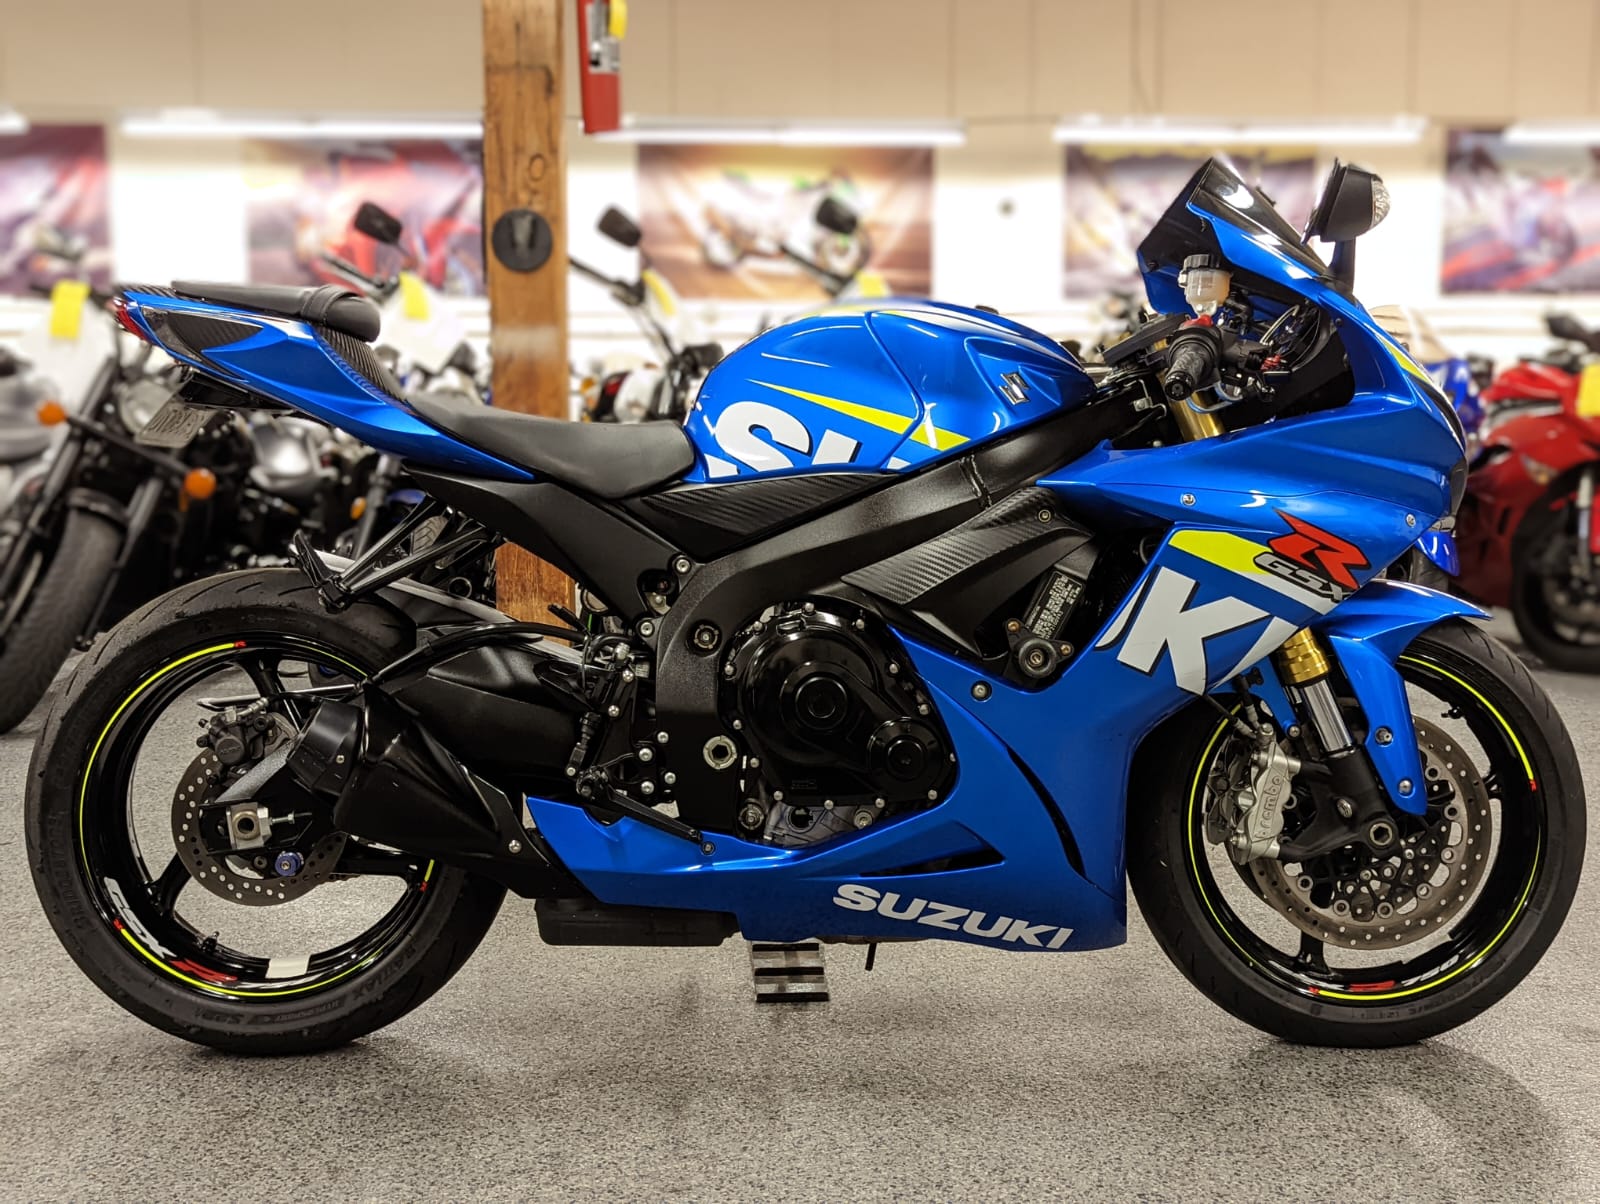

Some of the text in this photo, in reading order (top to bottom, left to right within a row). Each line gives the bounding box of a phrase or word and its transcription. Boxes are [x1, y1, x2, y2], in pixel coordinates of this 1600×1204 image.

[1254, 775, 1284, 840] brembo
[104, 877, 177, 959] GSX
[833, 884, 1074, 949] SUZUKI
